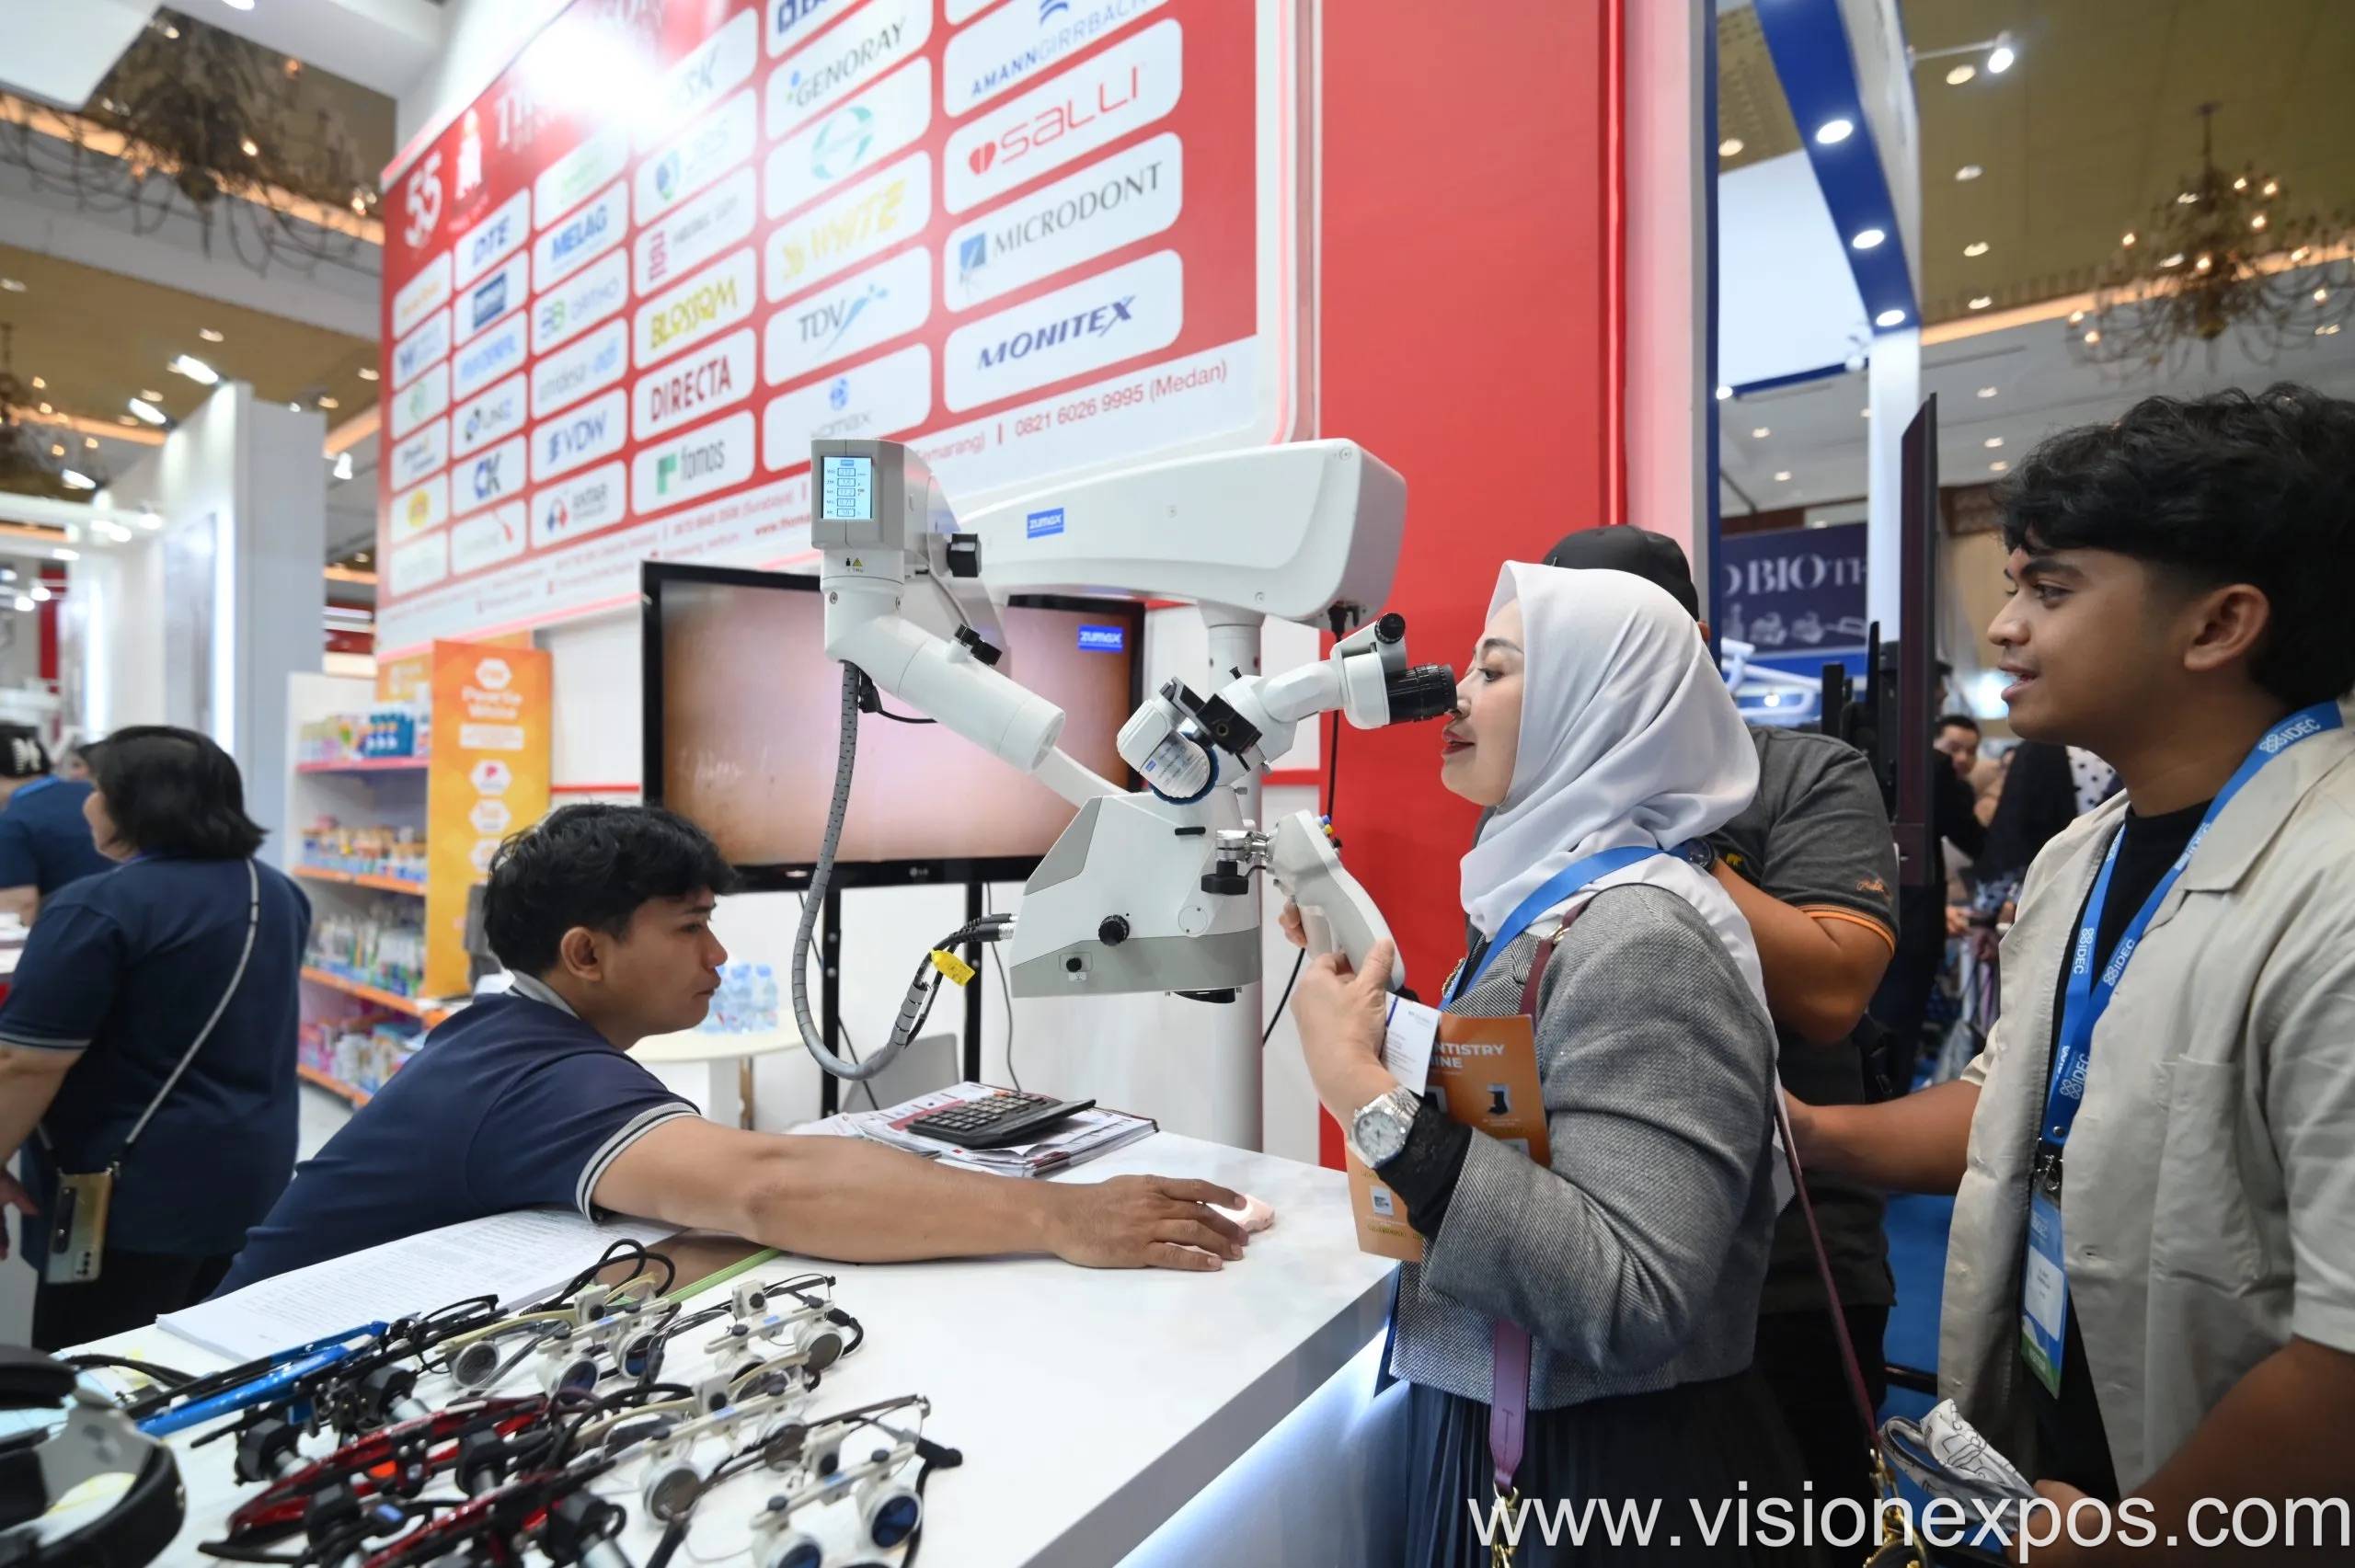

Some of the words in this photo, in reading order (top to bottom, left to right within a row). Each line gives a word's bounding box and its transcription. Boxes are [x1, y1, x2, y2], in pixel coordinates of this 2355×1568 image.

[795, 14, 906, 108] GENORAY
[993, 161, 1164, 259] MICRODONT
[649, 276, 738, 350] BLOSSOM
[798, 297, 845, 343] TDV
[976, 294, 1138, 372] MONITEX
[651, 355, 732, 423] DIRECTA
[565, 410, 607, 453] VDW
[915, 433, 985, 464] emarang)
[1015, 412, 1052, 437] 0821
[1057, 399, 1097, 425] 6026
[1102, 384, 1144, 412] 9995
[1149, 360, 1228, 402] (Medan)
[1079, 630, 1123, 644] zumax
[2280, 718, 2321, 742] IDEC
[2074, 944, 2087, 975] IDEC
[2114, 938, 2135, 971] IDEC
[1430, 1057, 1464, 1069] INE
[2071, 1052, 2091, 1085] IDEC
